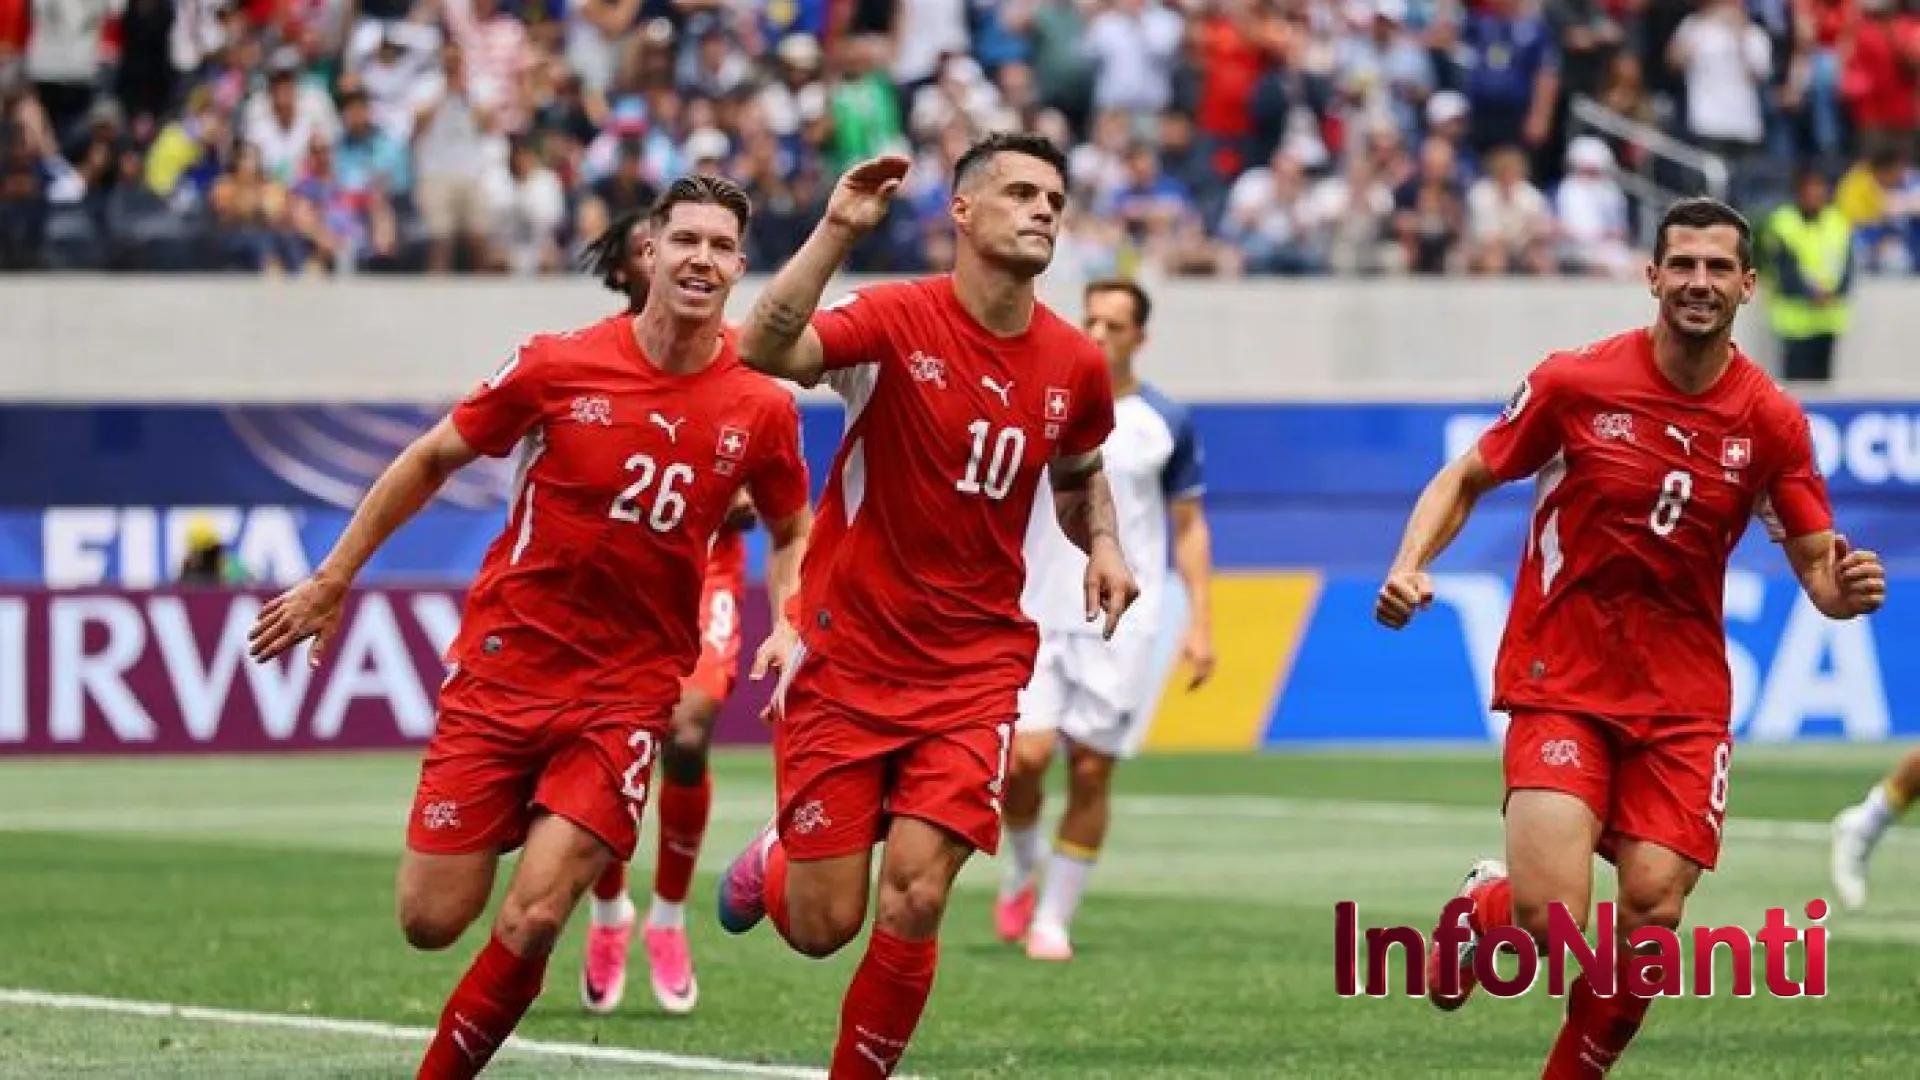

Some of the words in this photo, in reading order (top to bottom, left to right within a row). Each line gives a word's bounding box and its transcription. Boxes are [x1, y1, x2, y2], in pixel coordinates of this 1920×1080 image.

[609, 454, 694, 532] 26
[956, 421, 1026, 500] 10
[1650, 471, 1692, 535] 8
[44, 506, 311, 590] FIFA
[1431, 574, 1894, 742] VA
[621, 731, 661, 800] 2
[1710, 743, 1730, 811] 8
